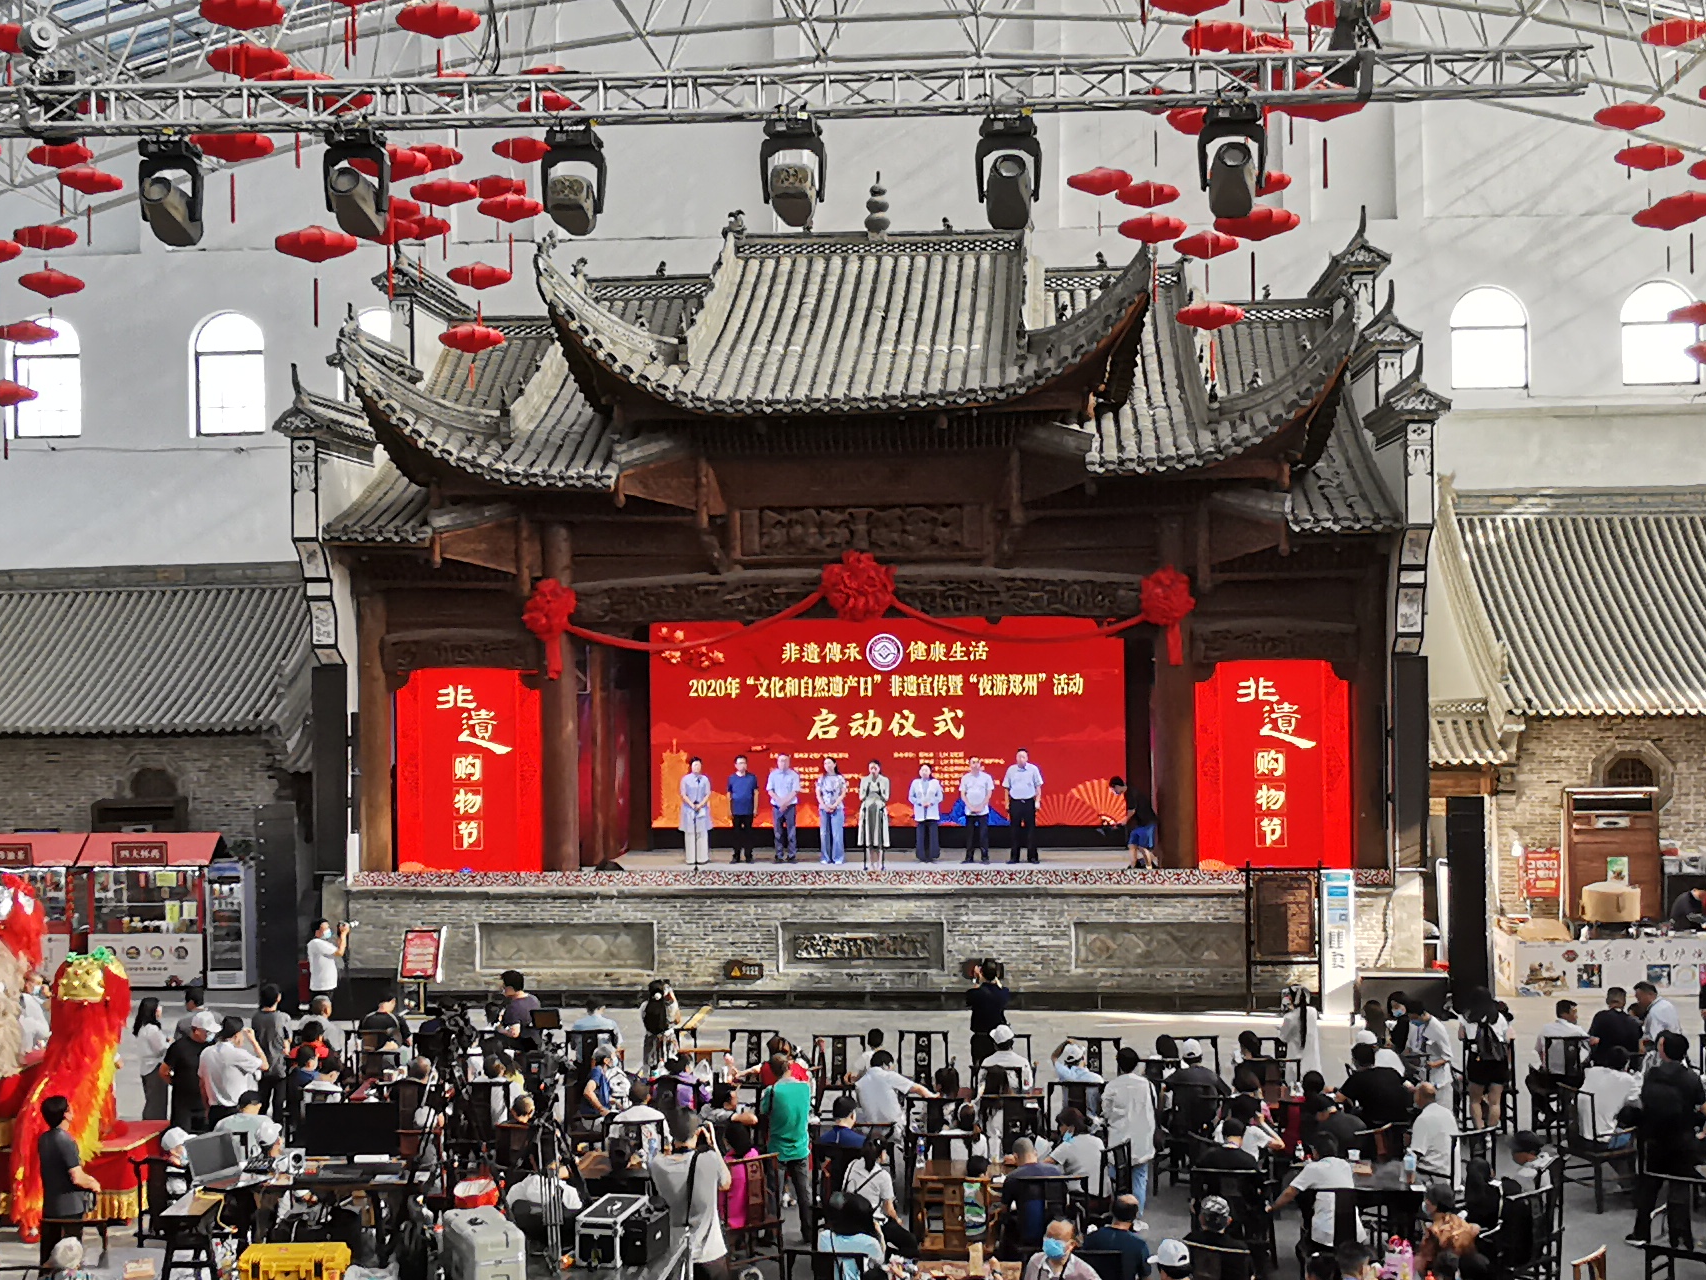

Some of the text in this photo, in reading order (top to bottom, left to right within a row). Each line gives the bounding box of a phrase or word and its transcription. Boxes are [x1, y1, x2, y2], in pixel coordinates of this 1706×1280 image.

[906, 641, 989, 662] 健康生活
[806, 707, 965, 741] 启动仪式
